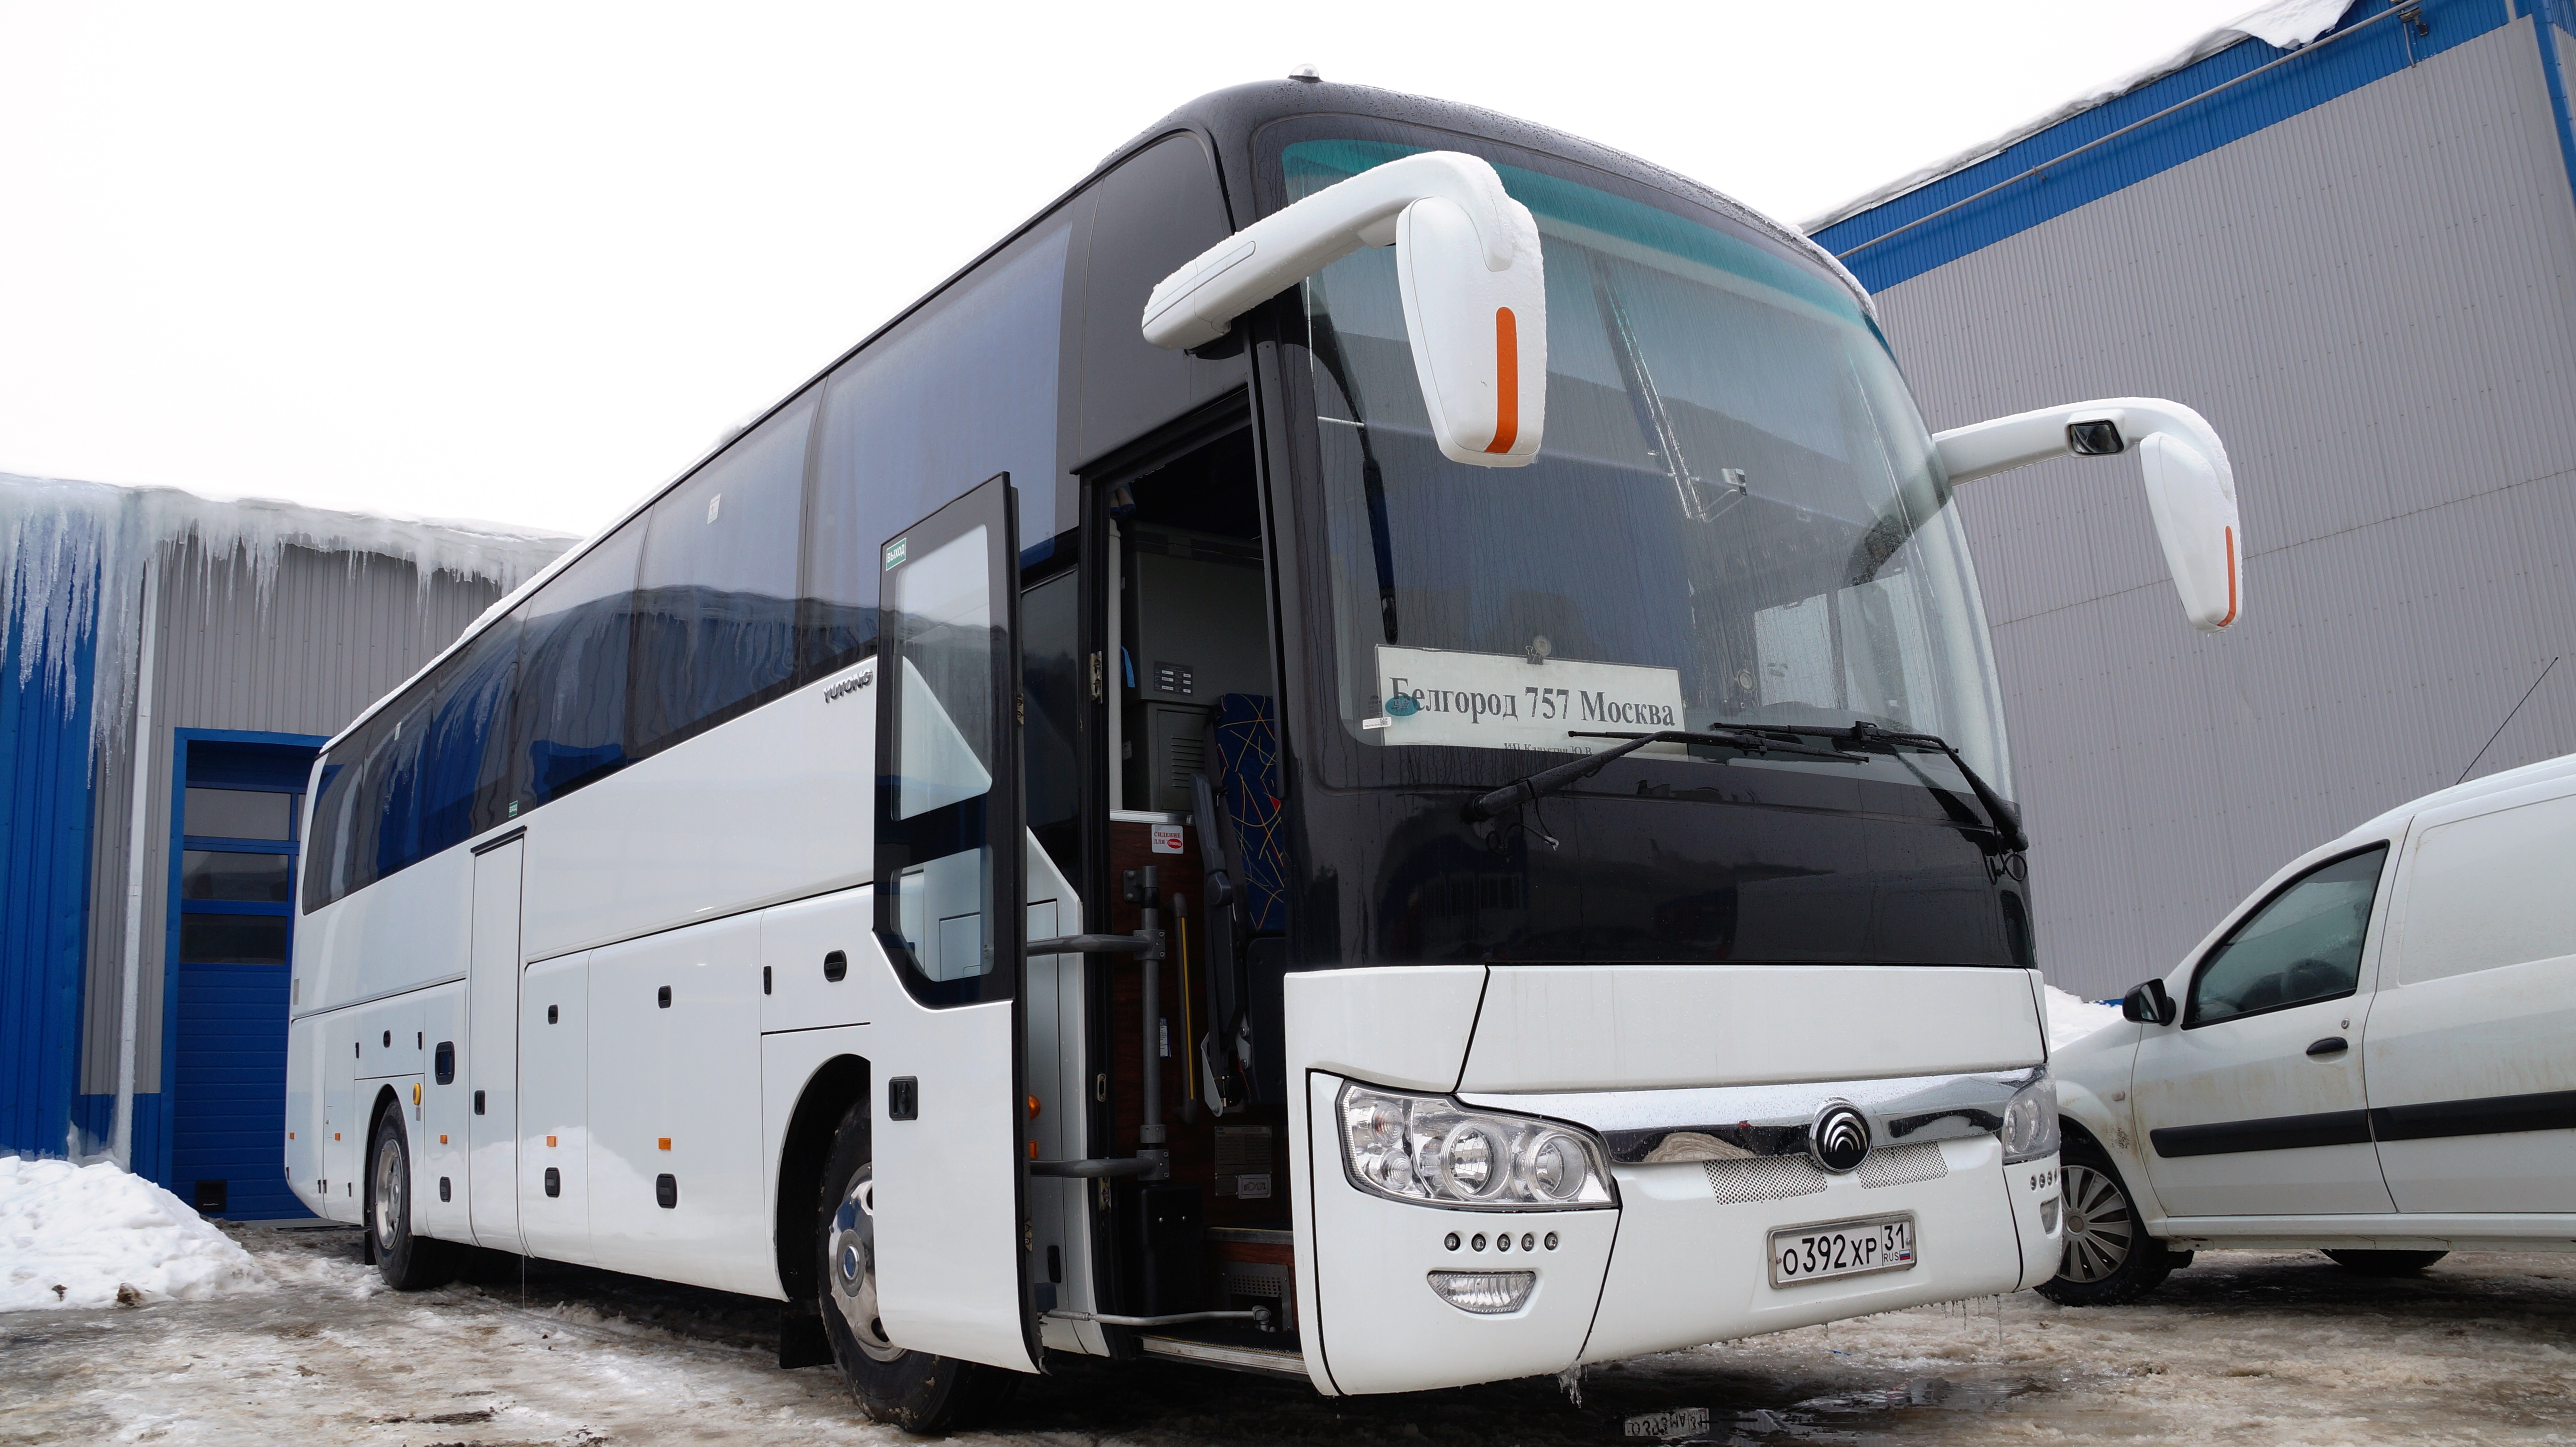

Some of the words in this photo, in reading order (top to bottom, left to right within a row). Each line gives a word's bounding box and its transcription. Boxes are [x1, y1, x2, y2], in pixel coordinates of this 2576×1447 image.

[887, 544, 905, 563] ВЫХОД
[823, 668, 873, 704] YUTONG
[1389, 676, 1519, 724] Белгород
[1525, 686, 1570, 719] 757
[1578, 689, 1676, 726] Москва
[1783, 1234, 1877, 1275] О392ХР
[1884, 1223, 1905, 1251] 31
[1883, 1251, 1899, 1263] RUS
